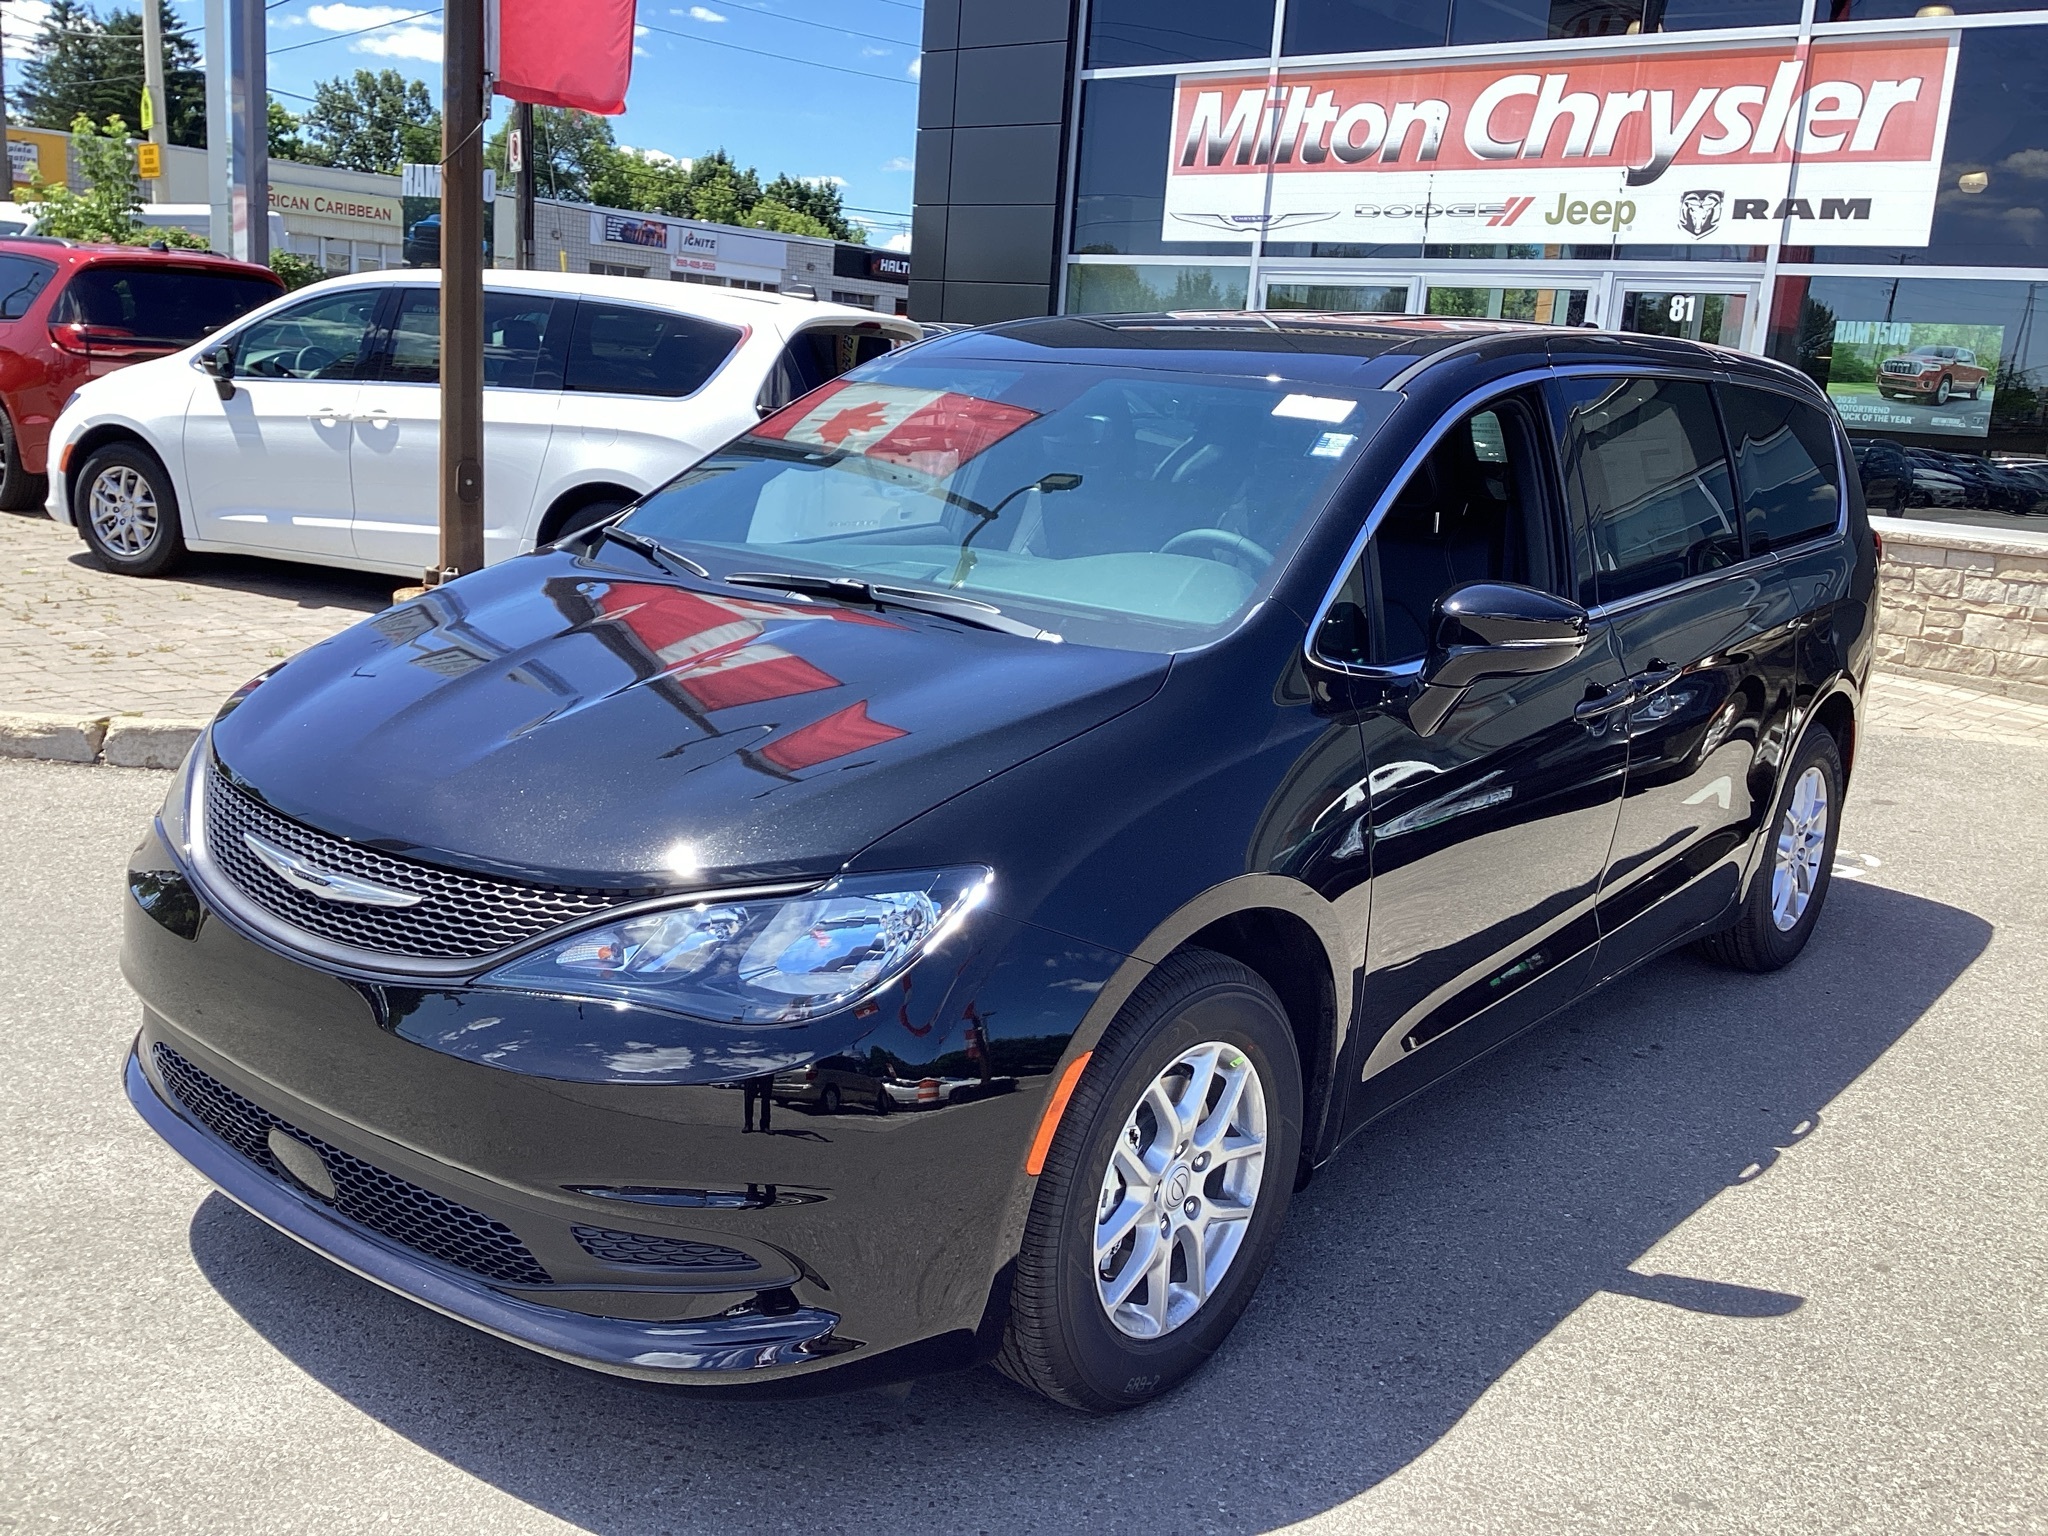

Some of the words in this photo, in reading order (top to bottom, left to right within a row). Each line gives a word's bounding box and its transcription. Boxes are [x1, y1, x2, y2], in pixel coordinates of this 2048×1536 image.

[1179, 84, 1451, 168] Milton
[1463, 59, 1924, 187] Chrysler
[314, 196, 392, 222] CARIBBEAN
[1353, 202, 1507, 218] DODGE
[1544, 192, 1637, 232] Jeep
[1731, 197, 1873, 220] RAM
[683, 235, 717, 249] IGNITE
[1668, 293, 1697, 322] 81
[1833, 320, 1871, 344] RAM
[1872, 321, 1912, 346] 1500
[1835, 395, 1858, 404] 2025
[1835, 404, 1891, 415] MOTORTREND
[1861, 413, 1873, 422] OF
[1874, 414, 1889, 423] THE
